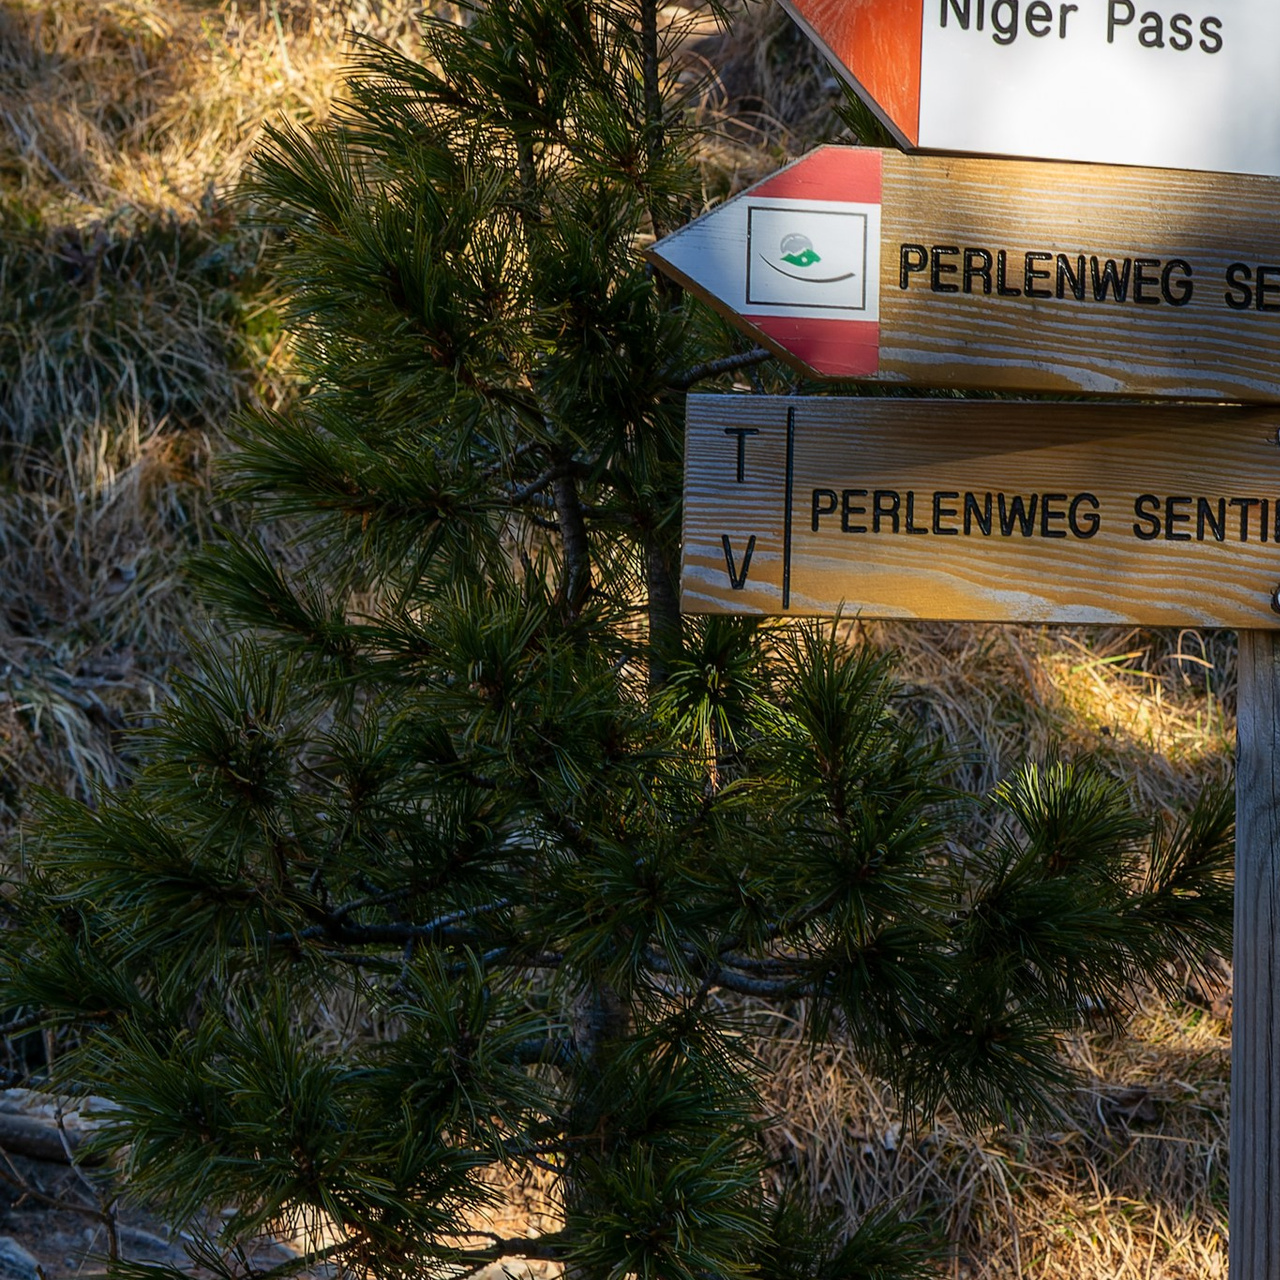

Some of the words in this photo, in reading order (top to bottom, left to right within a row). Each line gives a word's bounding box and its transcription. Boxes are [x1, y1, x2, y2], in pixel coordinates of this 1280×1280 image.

[900, 243, 1194, 307] PERLENWEG
[724, 427, 759, 484] T
[811, 488, 1101, 540] PERLENWEG
[721, 534, 757, 591] V
